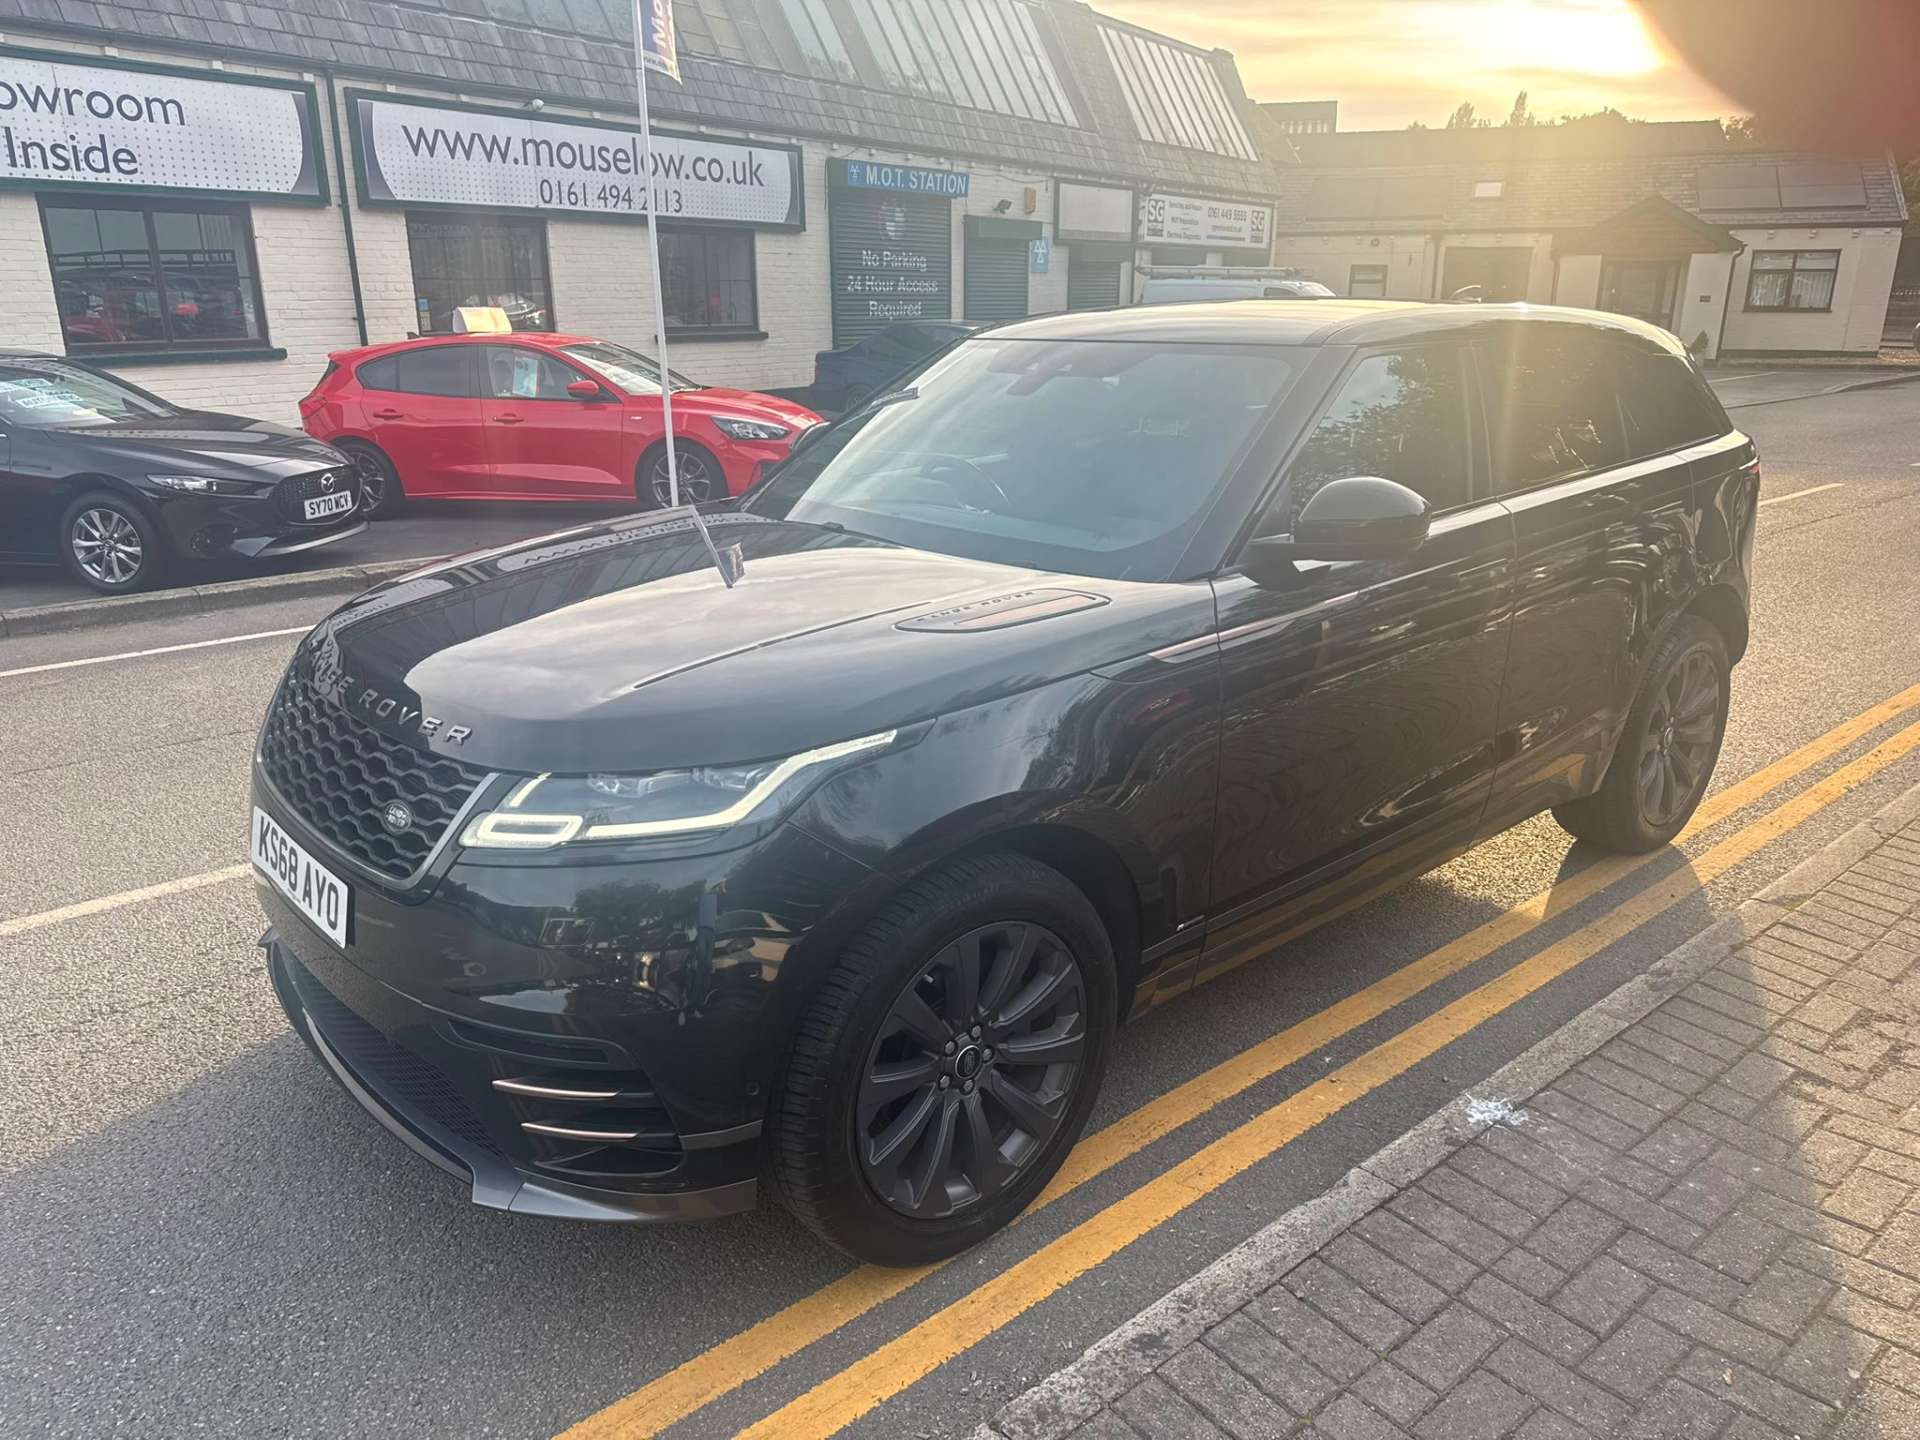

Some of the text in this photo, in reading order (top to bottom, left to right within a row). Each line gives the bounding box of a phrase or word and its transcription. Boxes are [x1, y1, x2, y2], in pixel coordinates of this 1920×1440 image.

[0, 80, 186, 126] owroom
[4, 126, 139, 175] Inside
[401, 124, 765, 187] www.mouselow.co.uk
[539, 178, 683, 213] 0161 494 2113
[865, 165, 967, 194] M.O.T. STATION
[1148, 200, 1164, 222] SG
[862, 250, 927, 272] No Parking
[847, 275, 938, 292] 24 Hour Access
[869, 300, 922, 320] Required
[308, 497, 334, 516] SY70
[358, 688, 473, 746] ROVER
[258, 814, 340, 931] KS68 AYO
